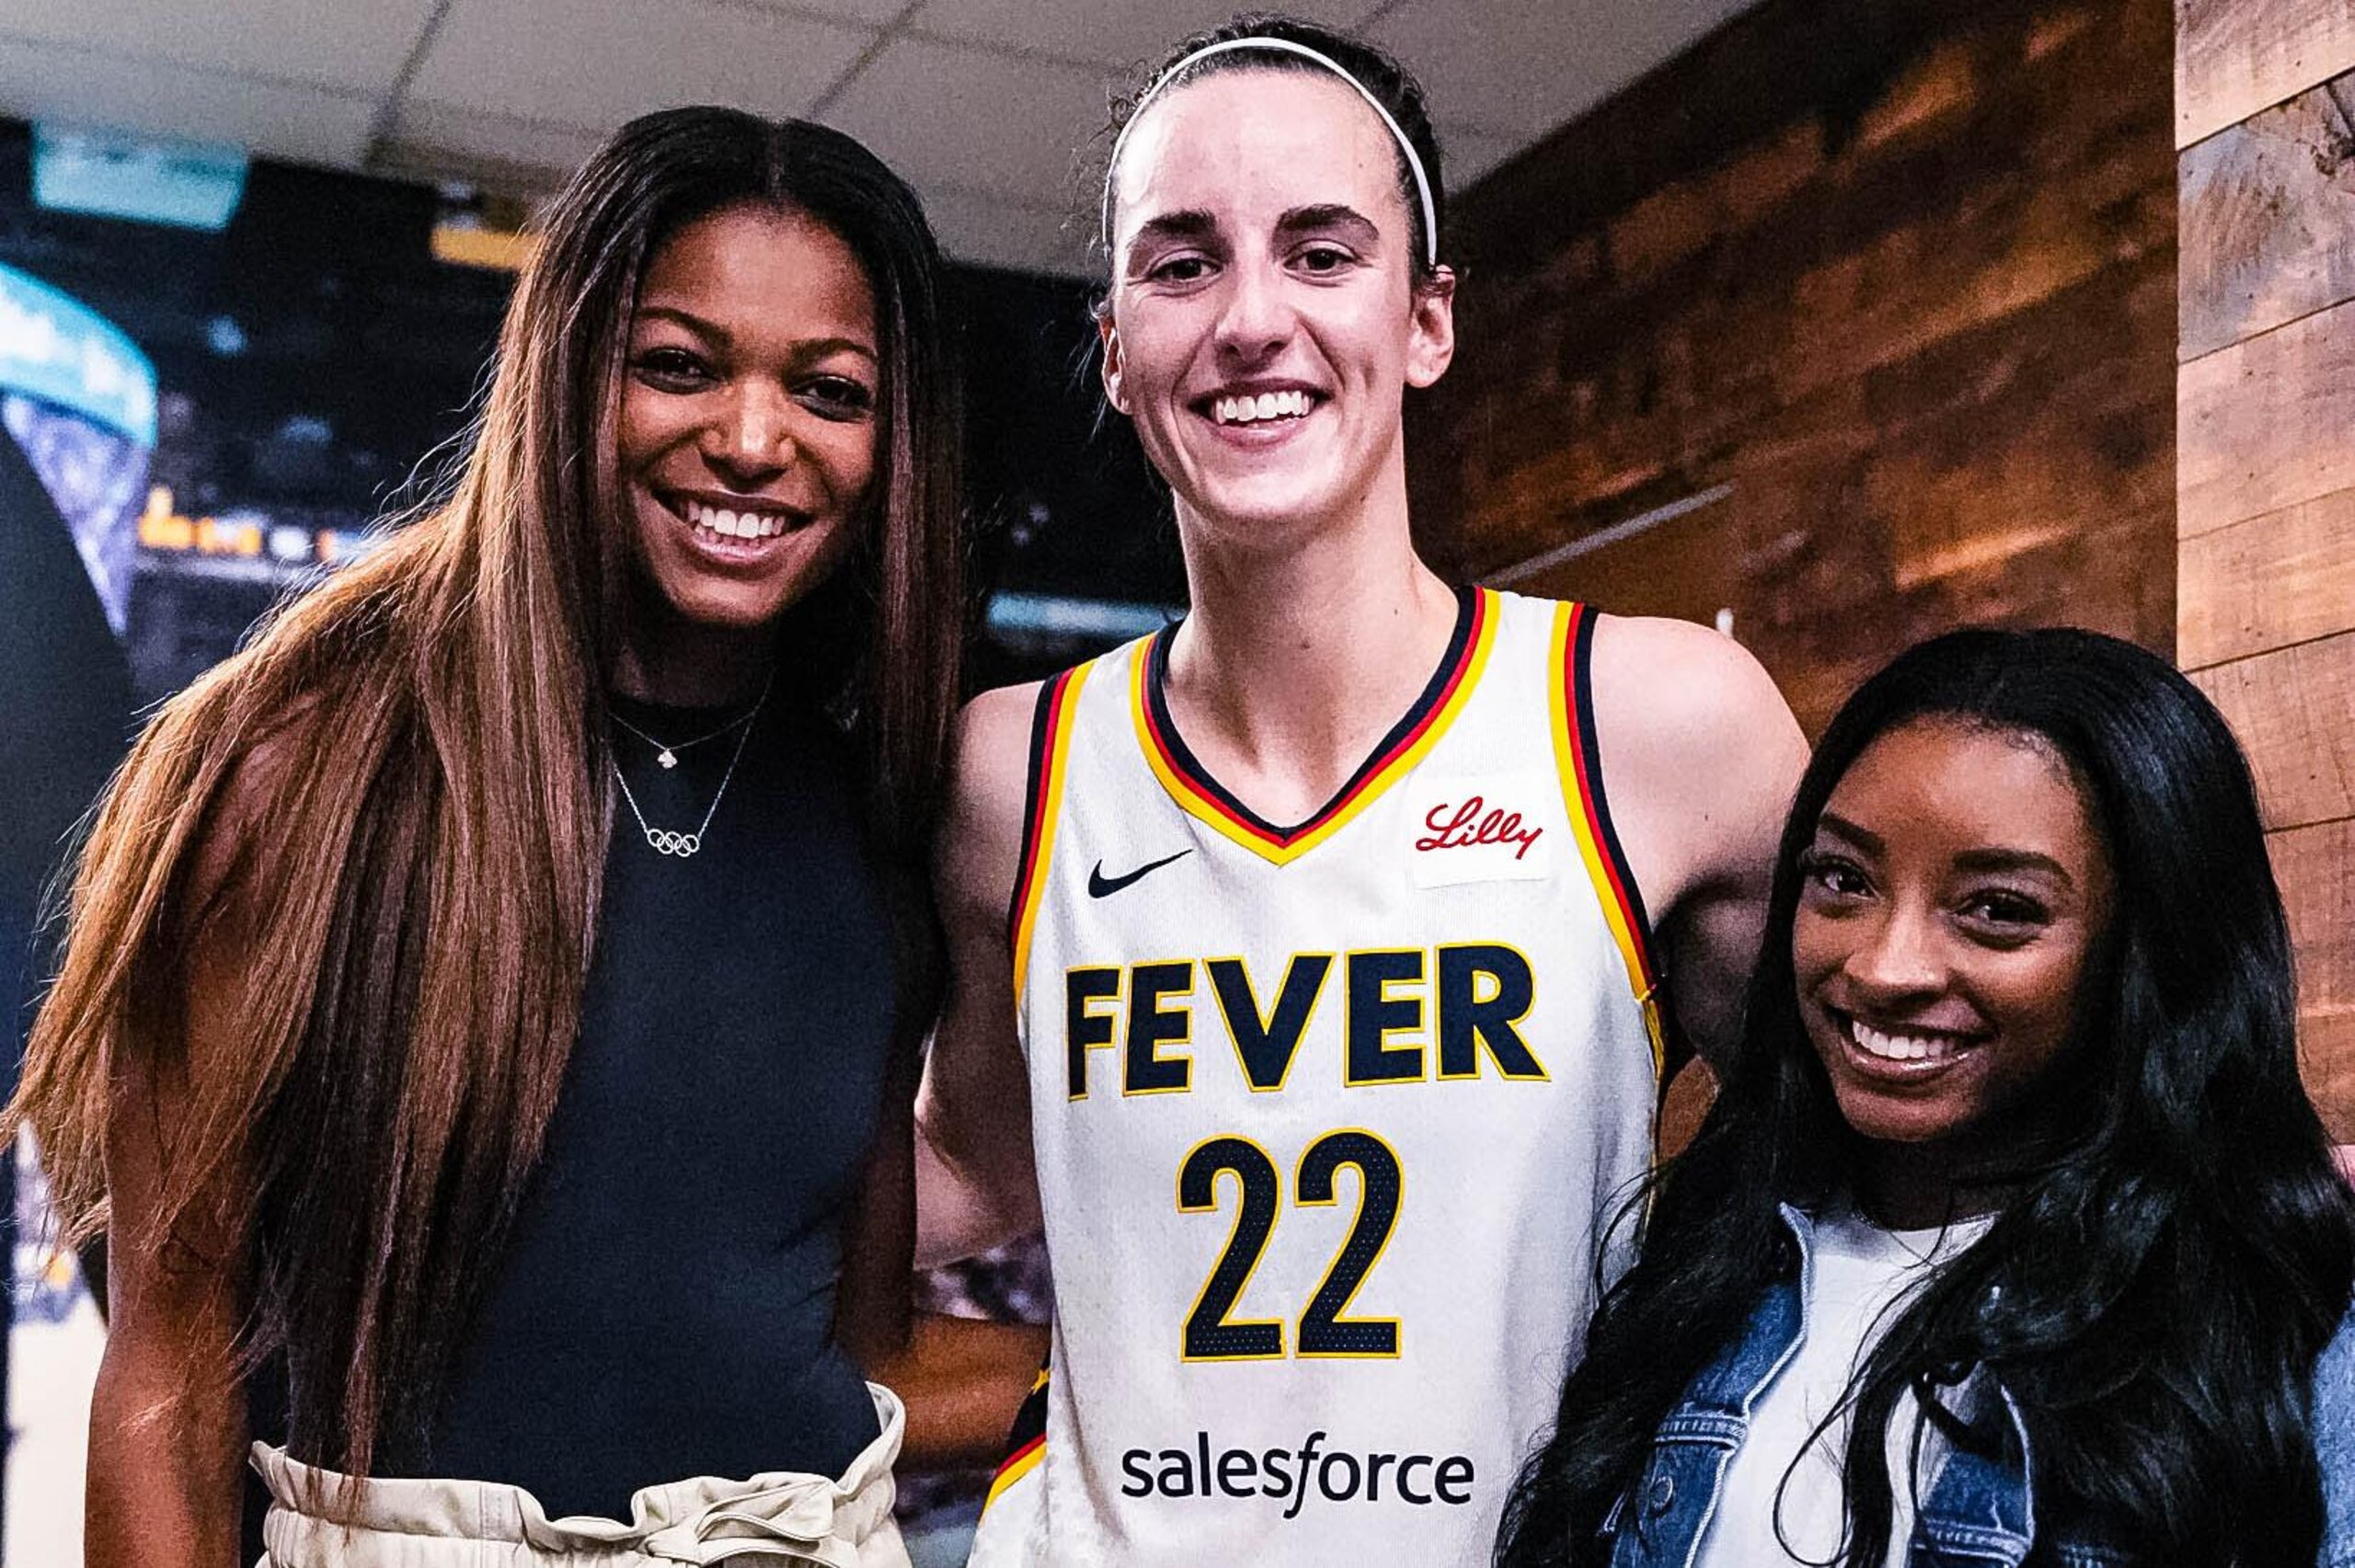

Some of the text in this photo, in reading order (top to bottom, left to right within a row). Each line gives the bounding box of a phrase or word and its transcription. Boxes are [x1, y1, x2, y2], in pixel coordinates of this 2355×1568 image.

[1415, 795, 1544, 861] Lilly
[1064, 942, 1551, 1102] FEVER
[1176, 1127, 1404, 1362] 22
[1120, 1431, 1476, 1519] salesforce
